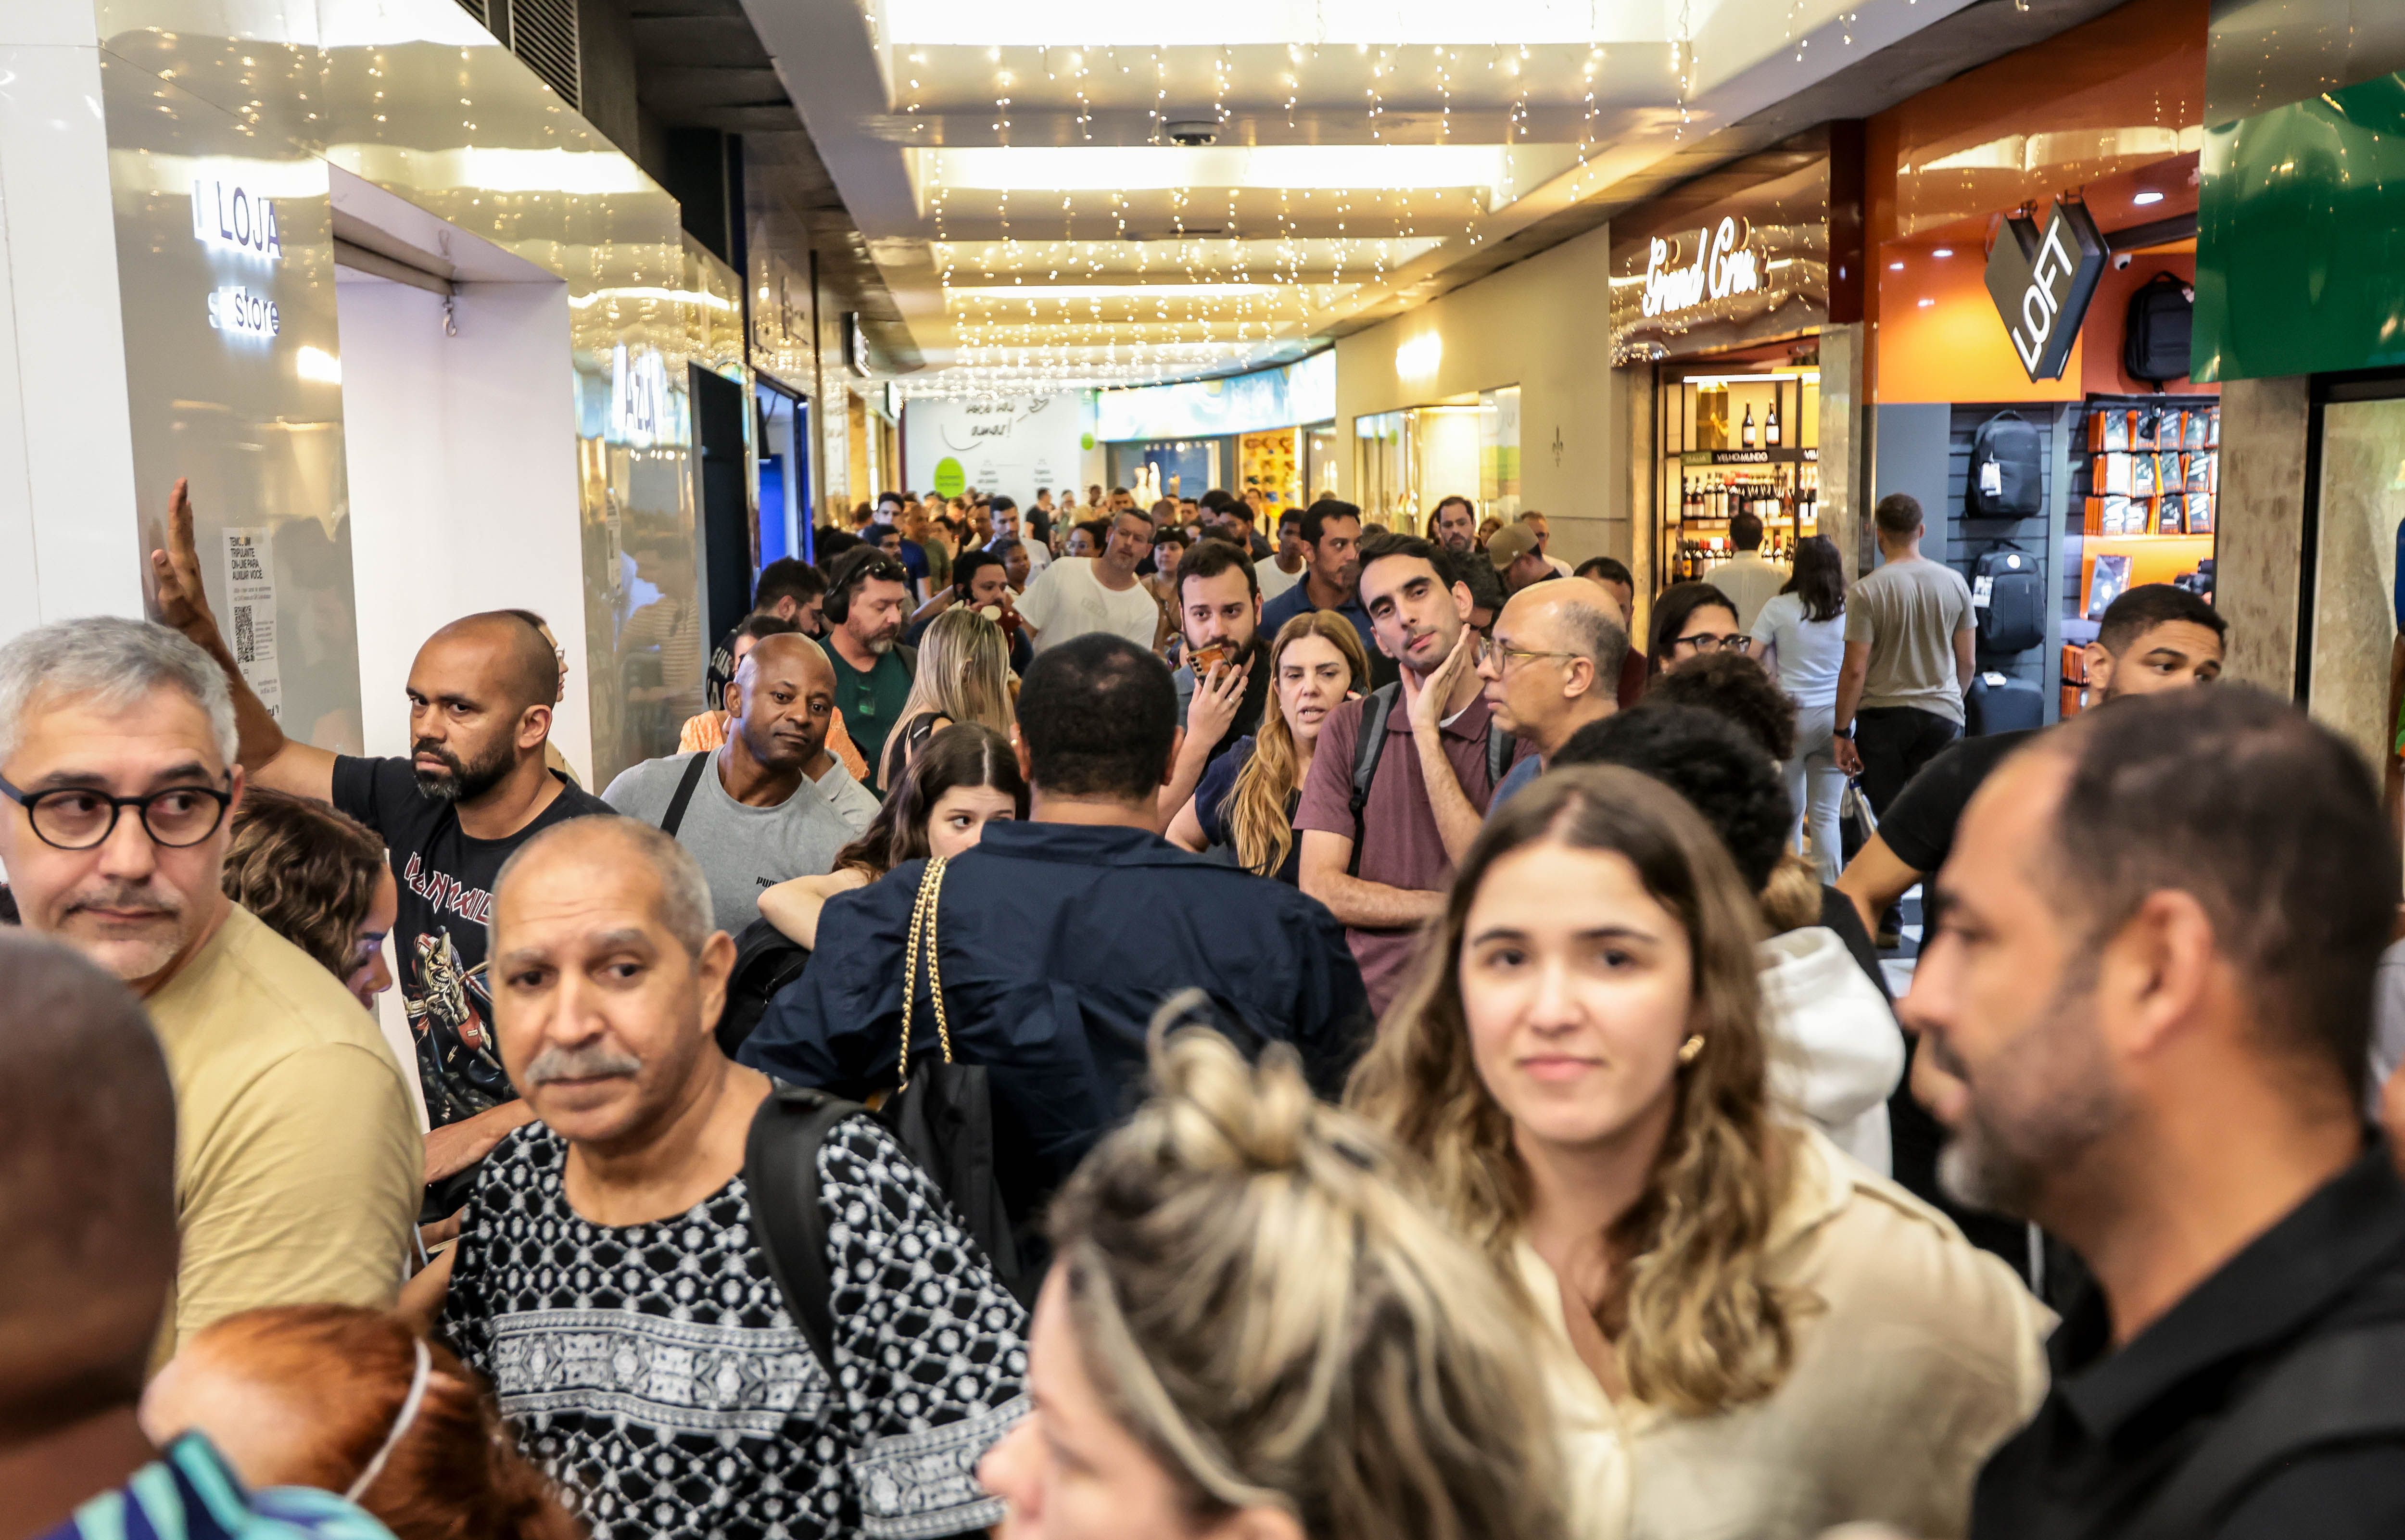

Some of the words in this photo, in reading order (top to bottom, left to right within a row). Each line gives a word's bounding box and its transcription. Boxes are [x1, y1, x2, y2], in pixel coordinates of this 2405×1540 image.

[216, 181, 282, 258] LOJA
[234, 288, 280, 335] store
[2012, 215, 2073, 374] LOFT
[1740, 452, 1768, 463] MUNDO
[230, 548, 255, 557] TRIPULANTE
